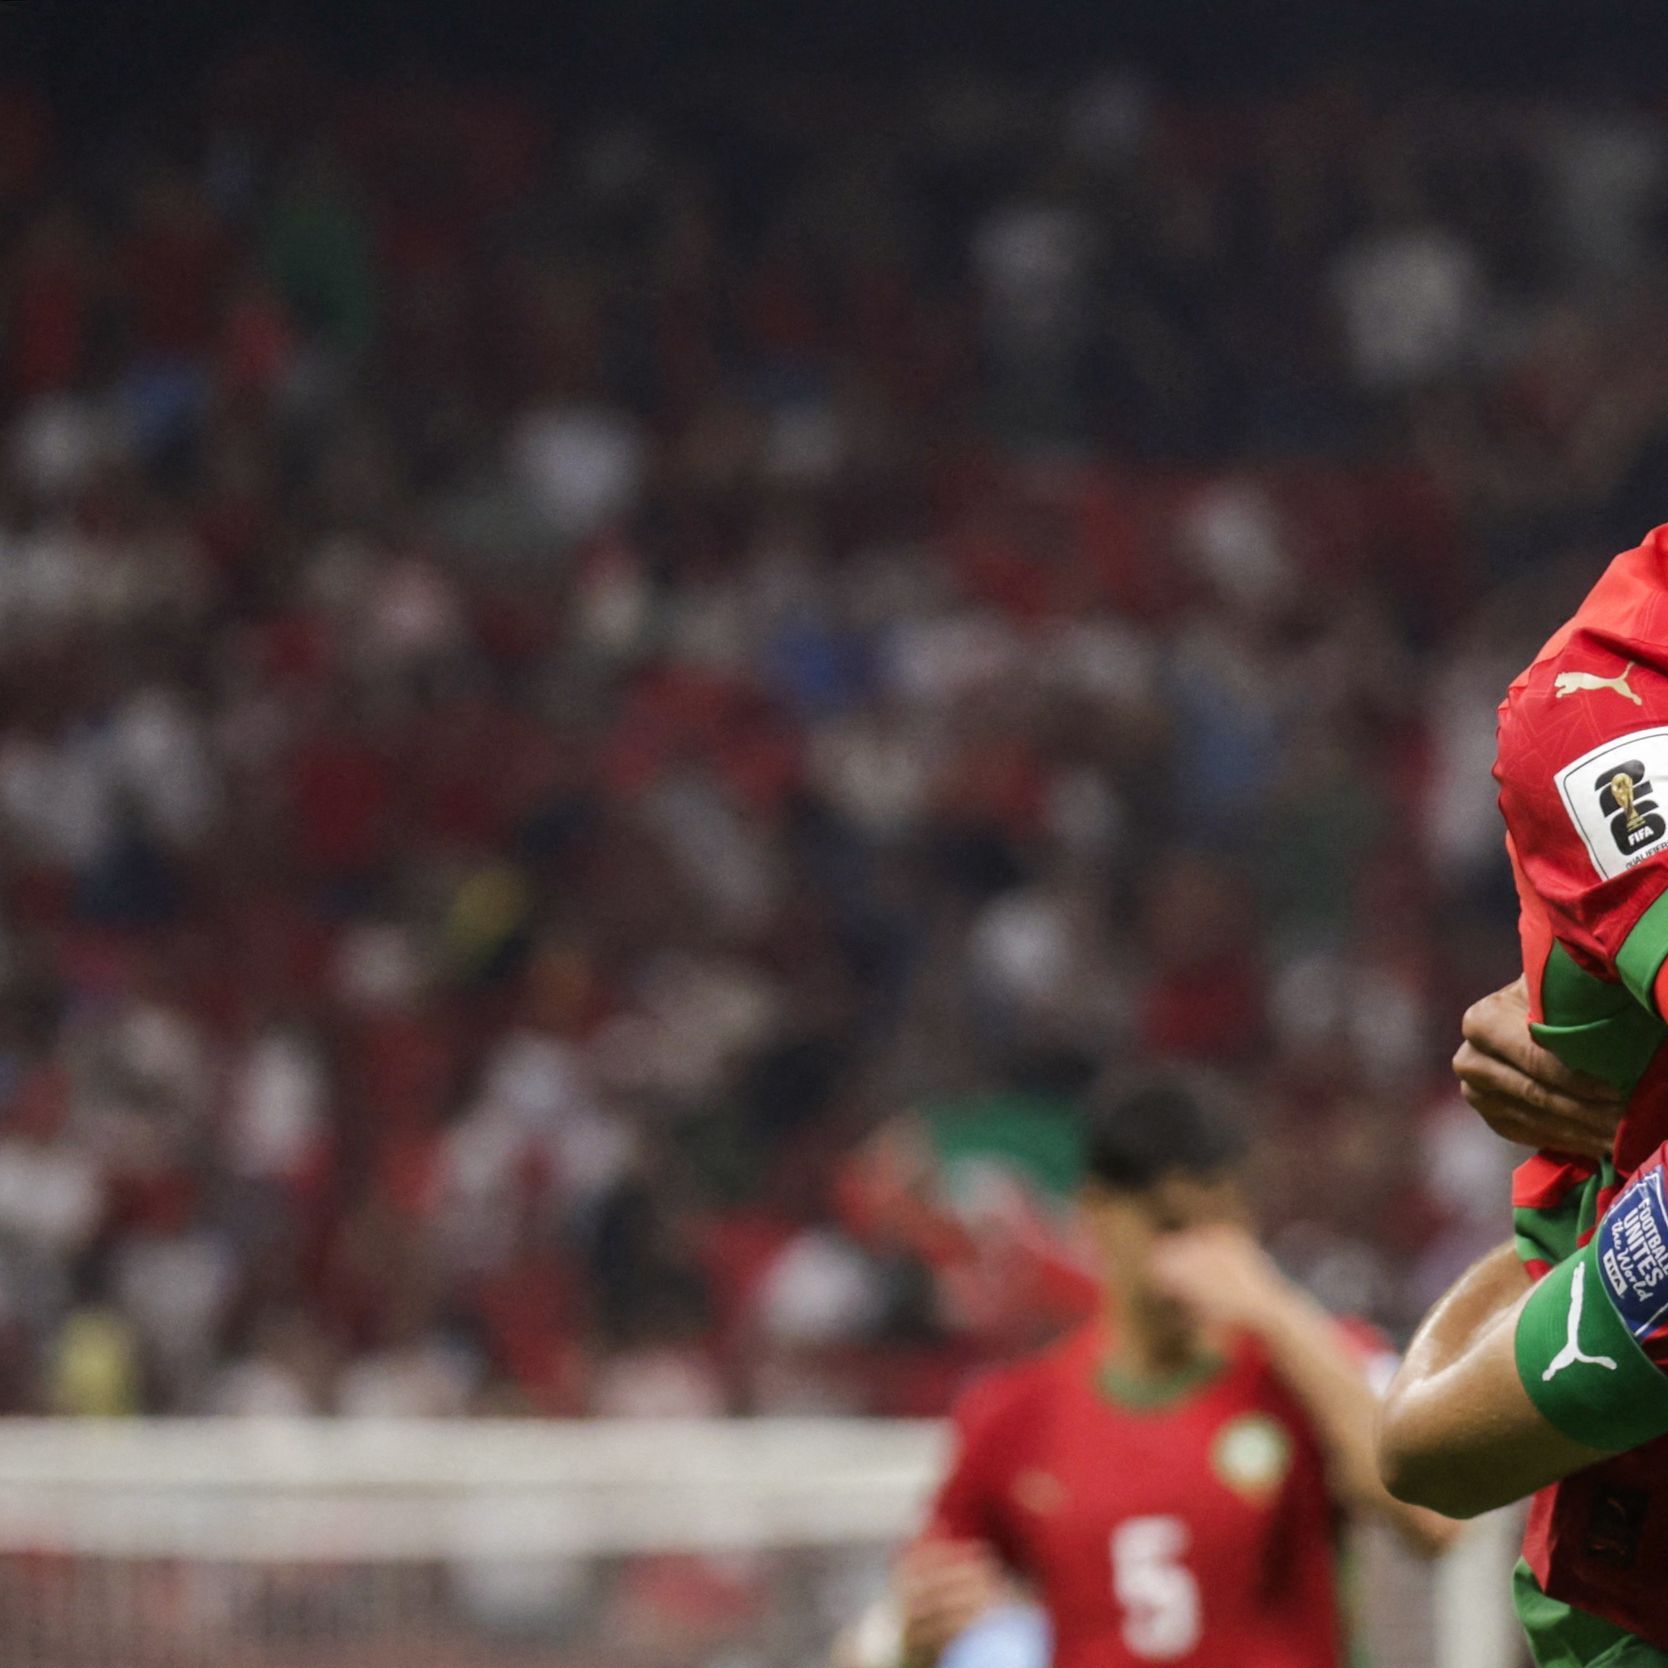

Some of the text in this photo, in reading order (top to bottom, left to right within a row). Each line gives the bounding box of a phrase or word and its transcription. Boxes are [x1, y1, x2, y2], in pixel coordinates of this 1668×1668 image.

[1627, 825, 1655, 847] FIFA
[1616, 1247, 1654, 1302] World
[1623, 1207, 1664, 1287] UNITES
[1109, 1513, 1204, 1662] 5
